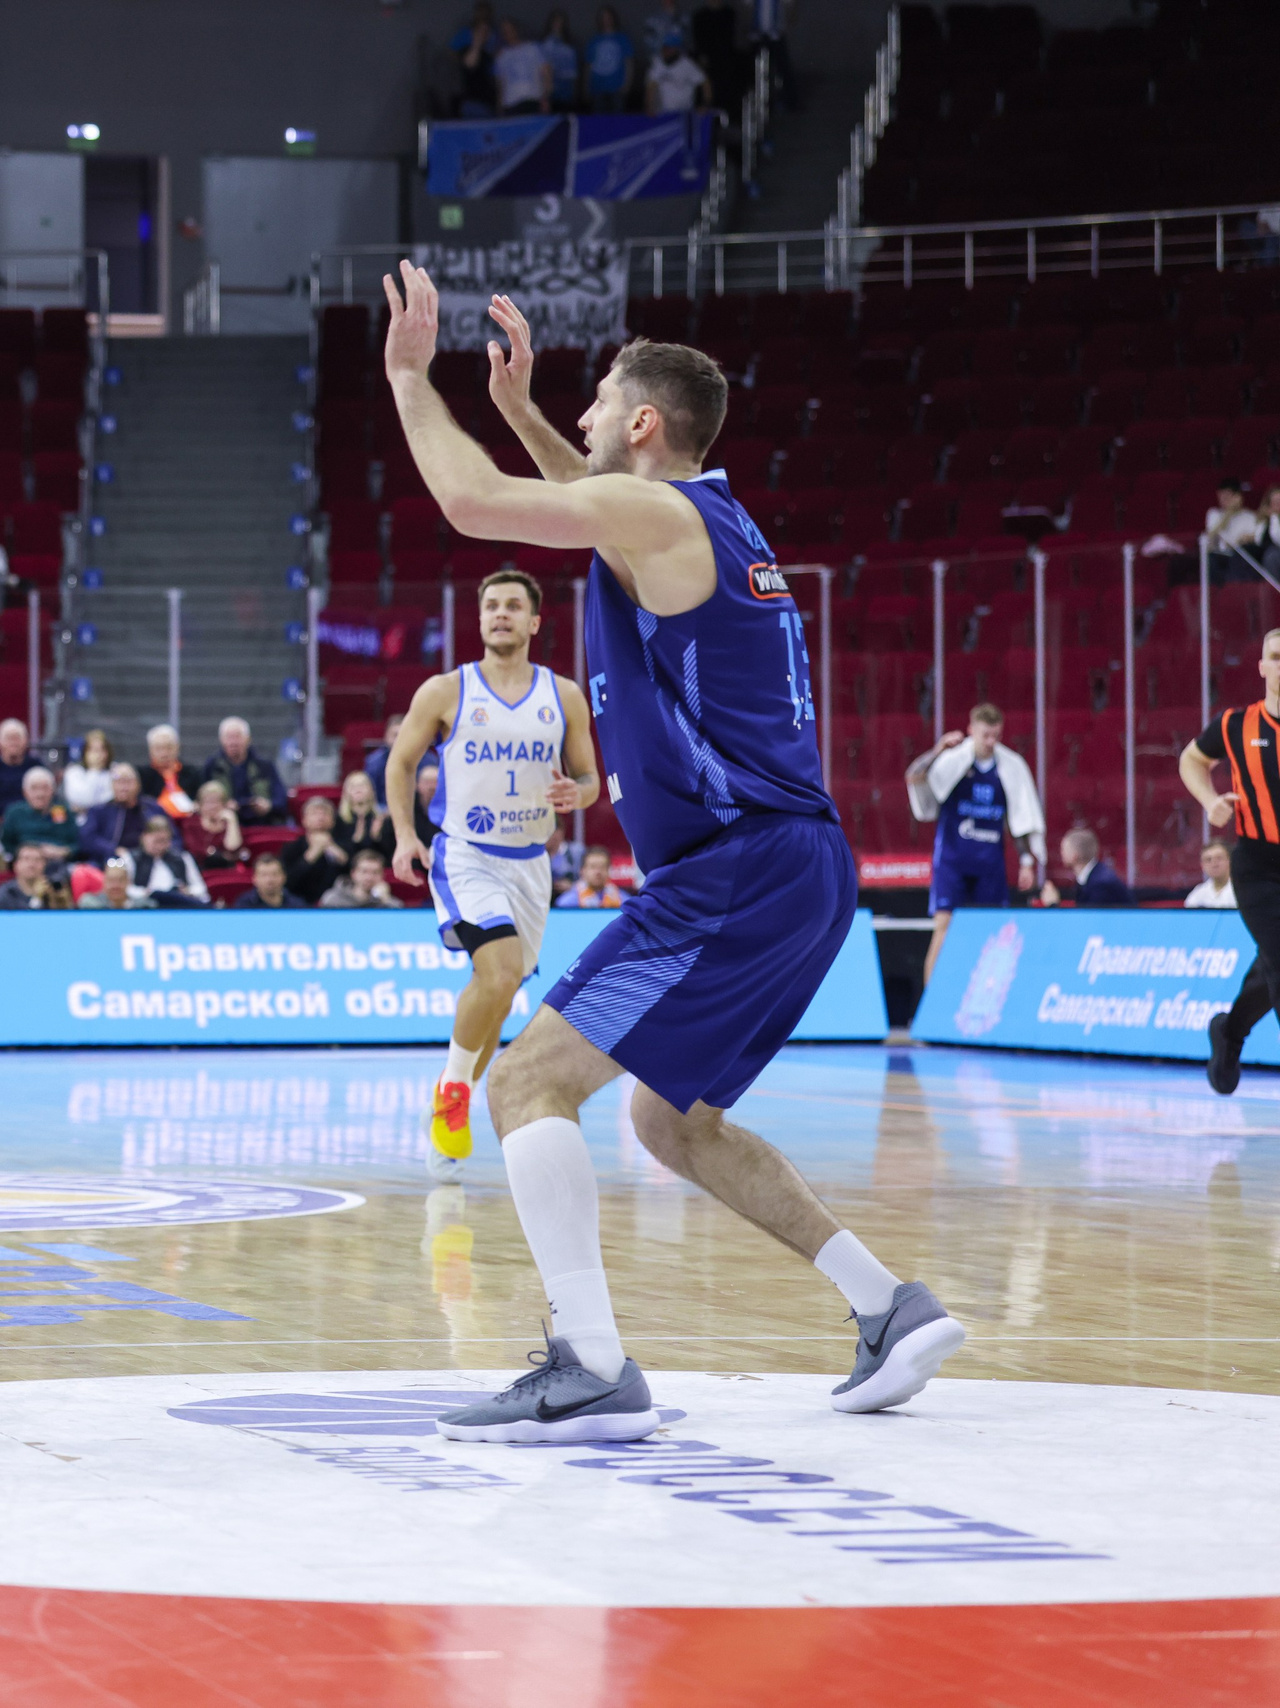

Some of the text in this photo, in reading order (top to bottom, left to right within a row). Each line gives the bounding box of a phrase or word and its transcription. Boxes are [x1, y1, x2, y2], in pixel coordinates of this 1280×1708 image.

[506, 770, 519, 796] 1
[121, 935, 471, 982] Правительство
[1077, 934, 1240, 986] Правительство
[66, 981, 330, 1030] Самарской
[1036, 982, 1156, 1036] Самарской
[285, 1445, 523, 1493] ВОЛГА
